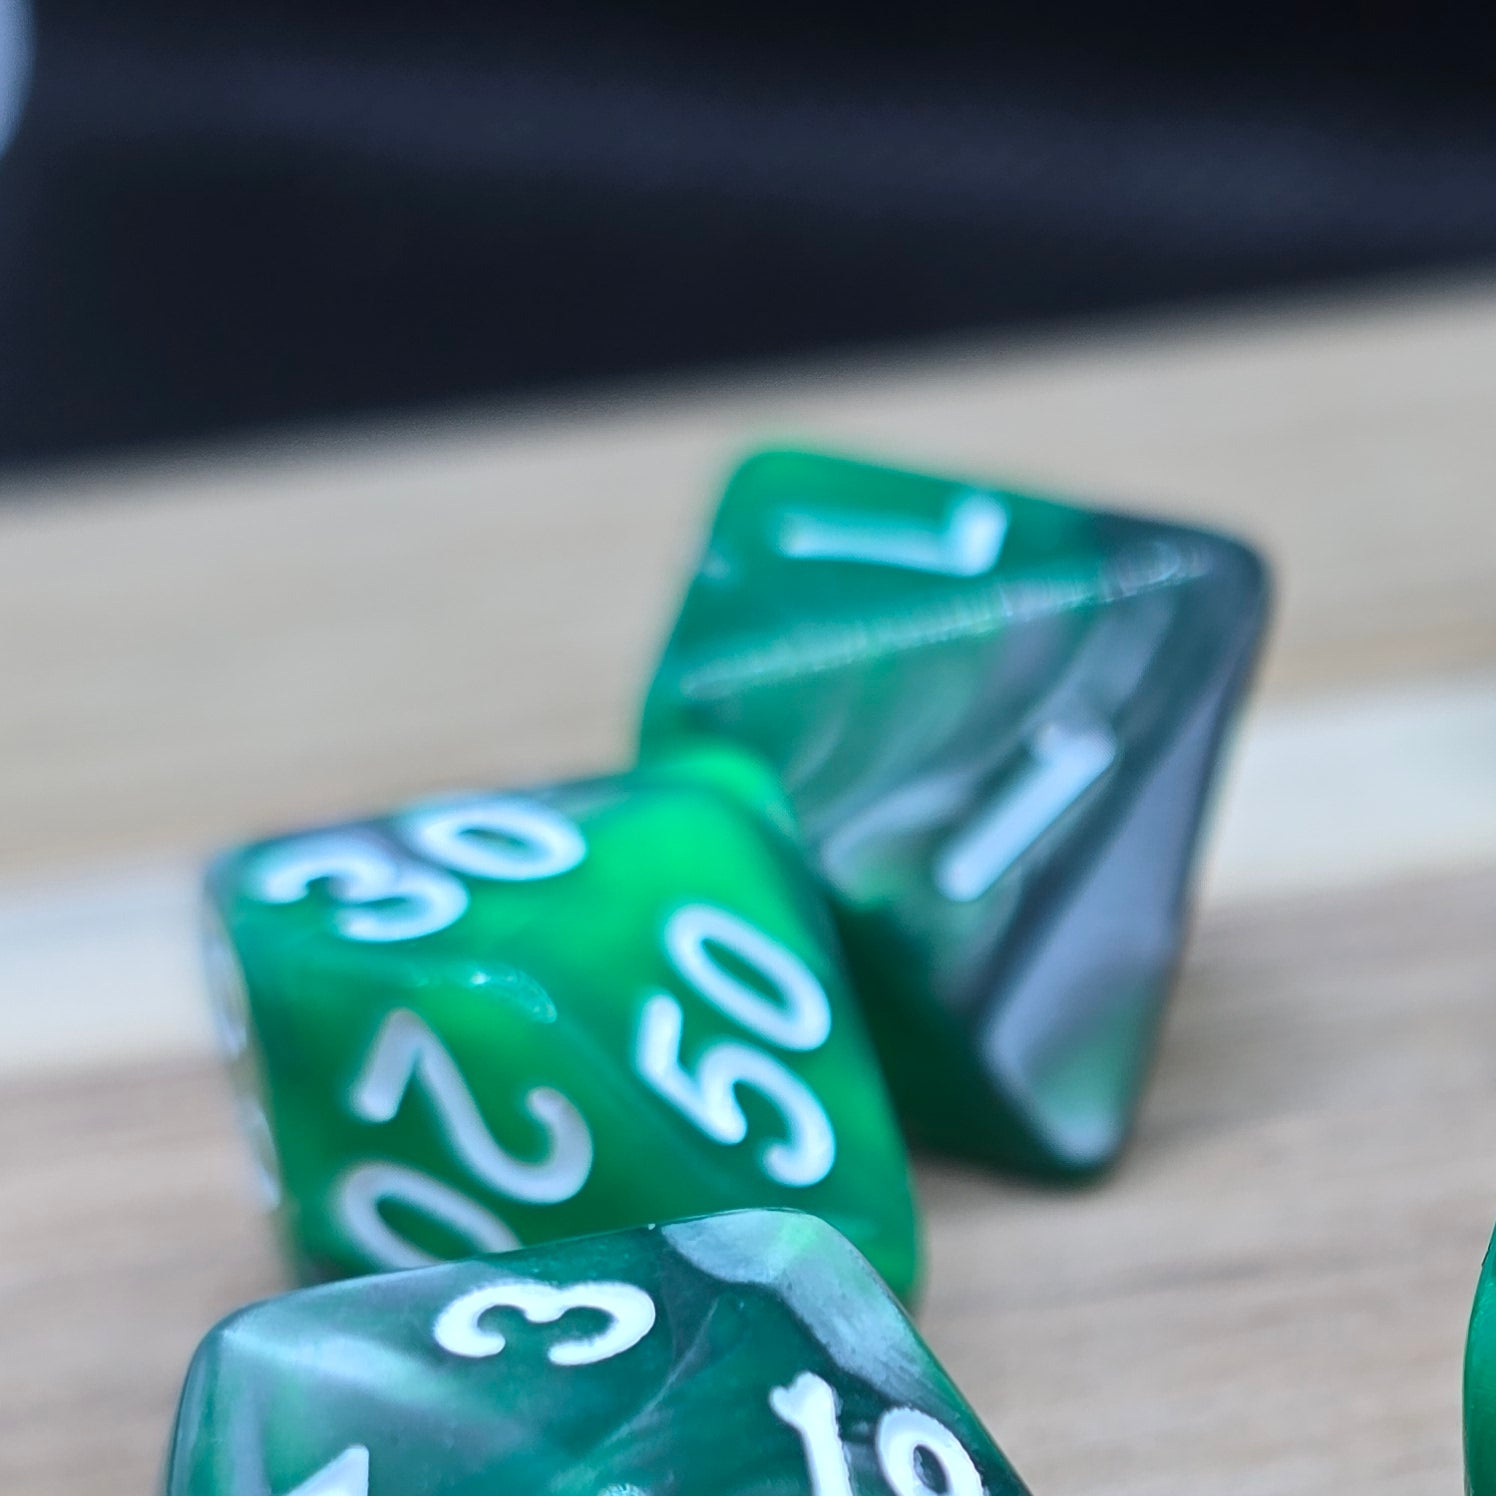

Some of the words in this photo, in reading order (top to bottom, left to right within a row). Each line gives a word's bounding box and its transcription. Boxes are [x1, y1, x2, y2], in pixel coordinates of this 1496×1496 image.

[258, 800, 588, 942] 30
[632, 902, 832, 1186] 50
[434, 1280, 656, 1366] 3
